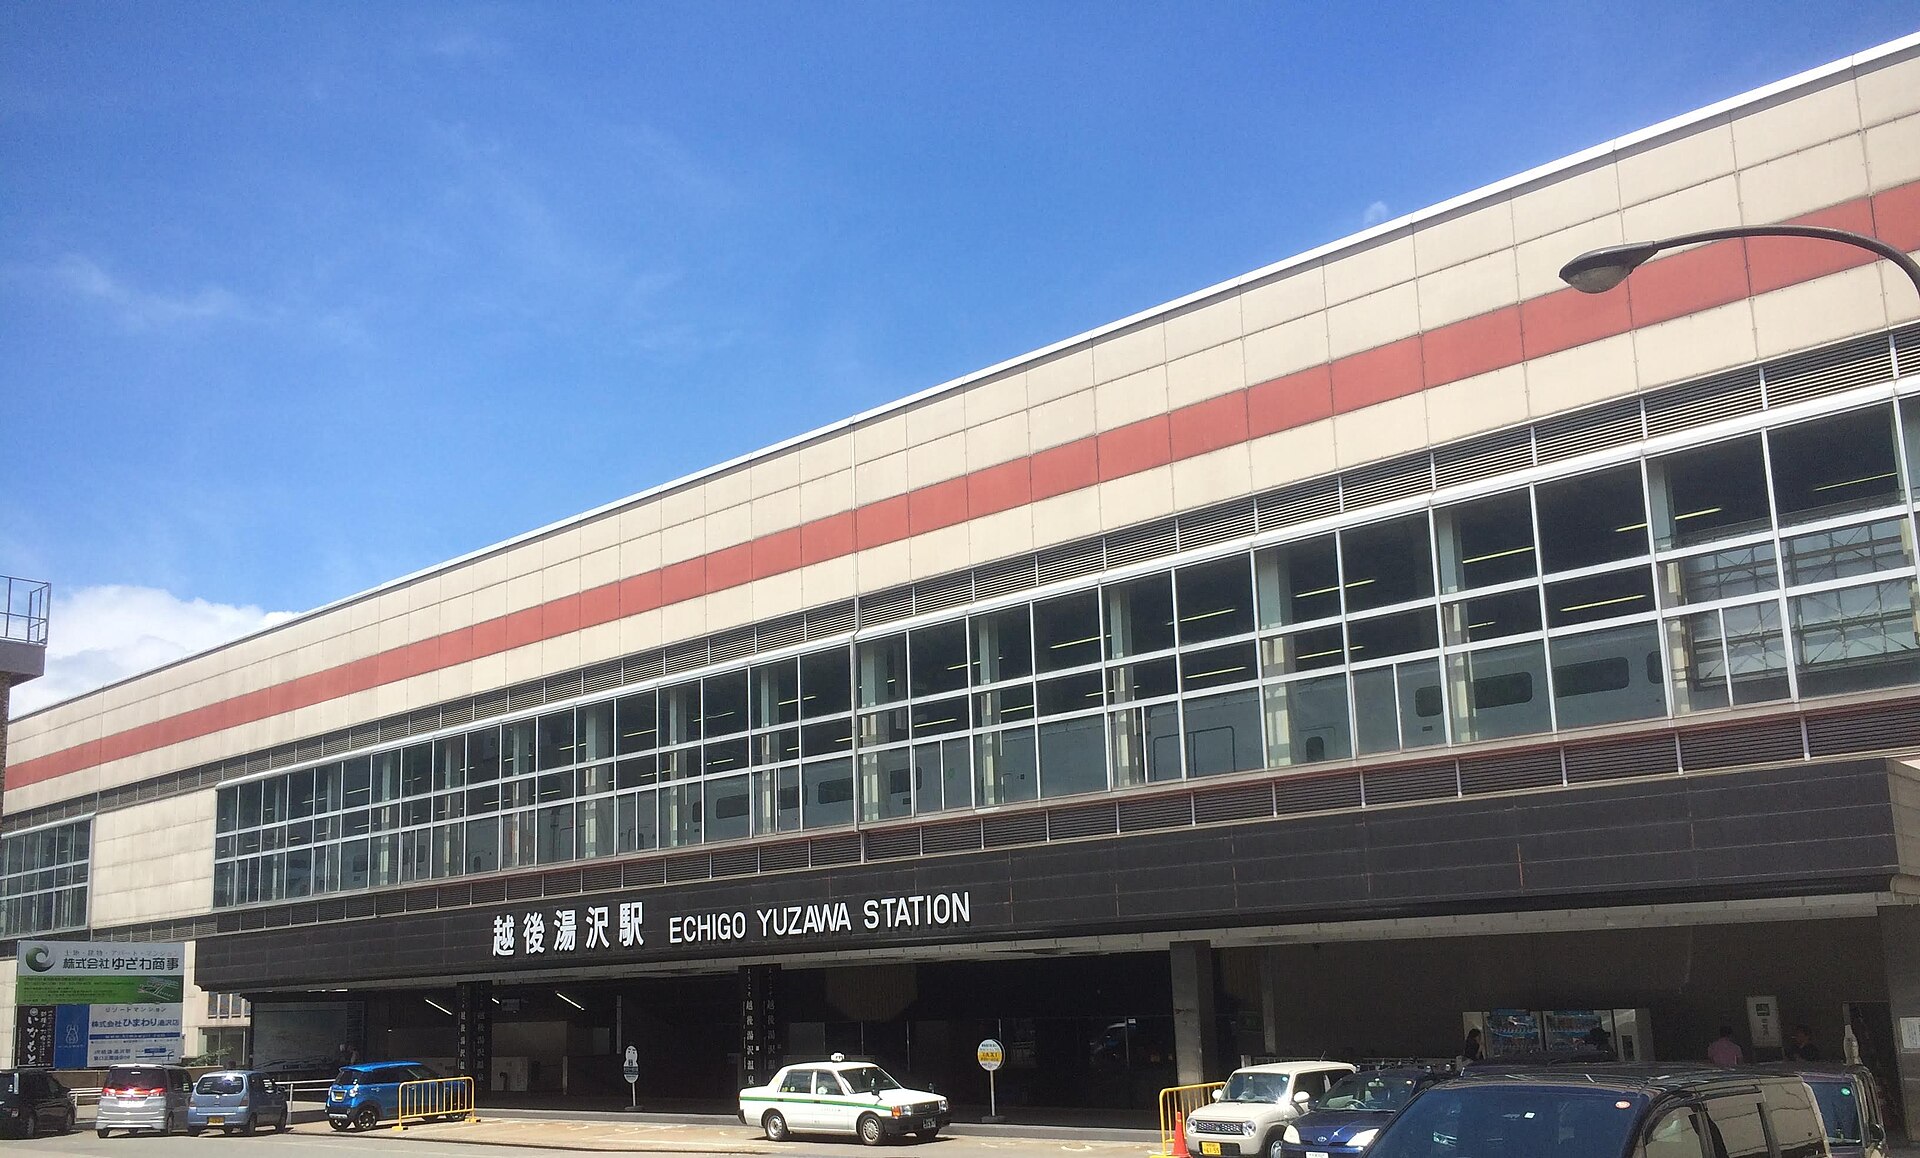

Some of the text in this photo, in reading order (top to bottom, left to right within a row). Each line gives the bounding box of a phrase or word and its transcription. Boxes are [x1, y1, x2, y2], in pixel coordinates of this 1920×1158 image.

[492, 902, 645, 956] 越後湯沢駅
[669, 891, 970, 944] ECHIGO YUZAWA STATION
[62, 957, 179, 971] 株式会社ゆざわ商事
[27, 1016, 39, 1064] いなもと
